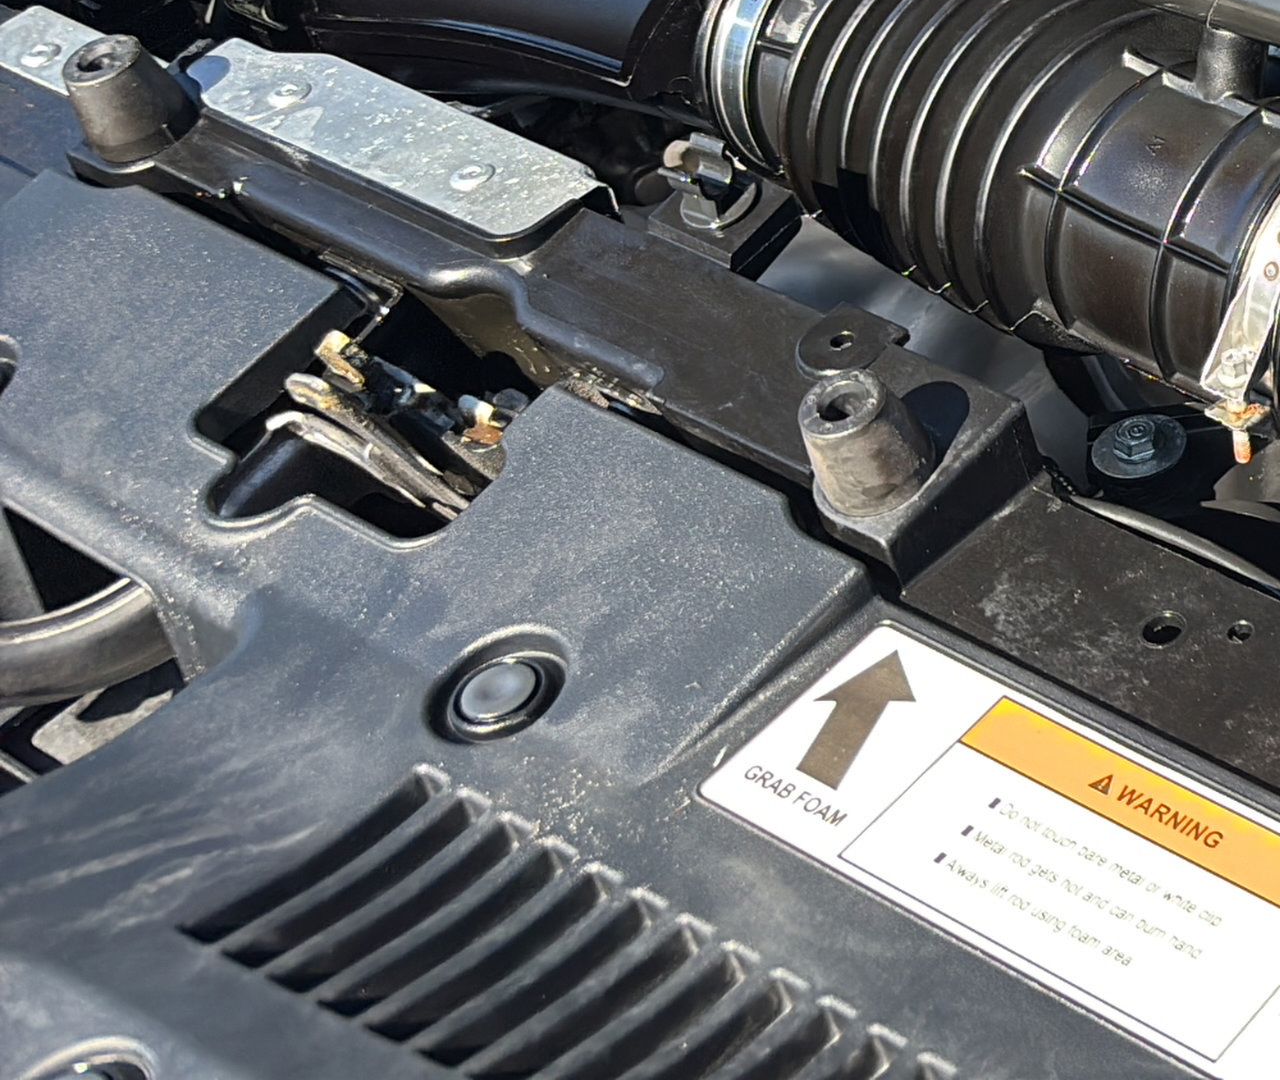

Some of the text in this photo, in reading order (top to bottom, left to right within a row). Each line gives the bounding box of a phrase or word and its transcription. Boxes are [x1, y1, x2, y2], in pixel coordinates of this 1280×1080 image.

[744, 765, 848, 827] GRAB FOAM
[1116, 784, 1225, 850] WARNING
[973, 830, 1008, 855] Metal
[1027, 864, 1060, 884] gets
[1082, 891, 1111, 910] and
[1109, 905, 1136, 922] can
[1109, 862, 1146, 886] metal
[1145, 882, 1161, 894] or
[1163, 890, 1197, 913] white
[946, 858, 989, 889] Always
[1030, 907, 1067, 933] using
[1068, 924, 1101, 949] foam
[1101, 945, 1133, 967] area
